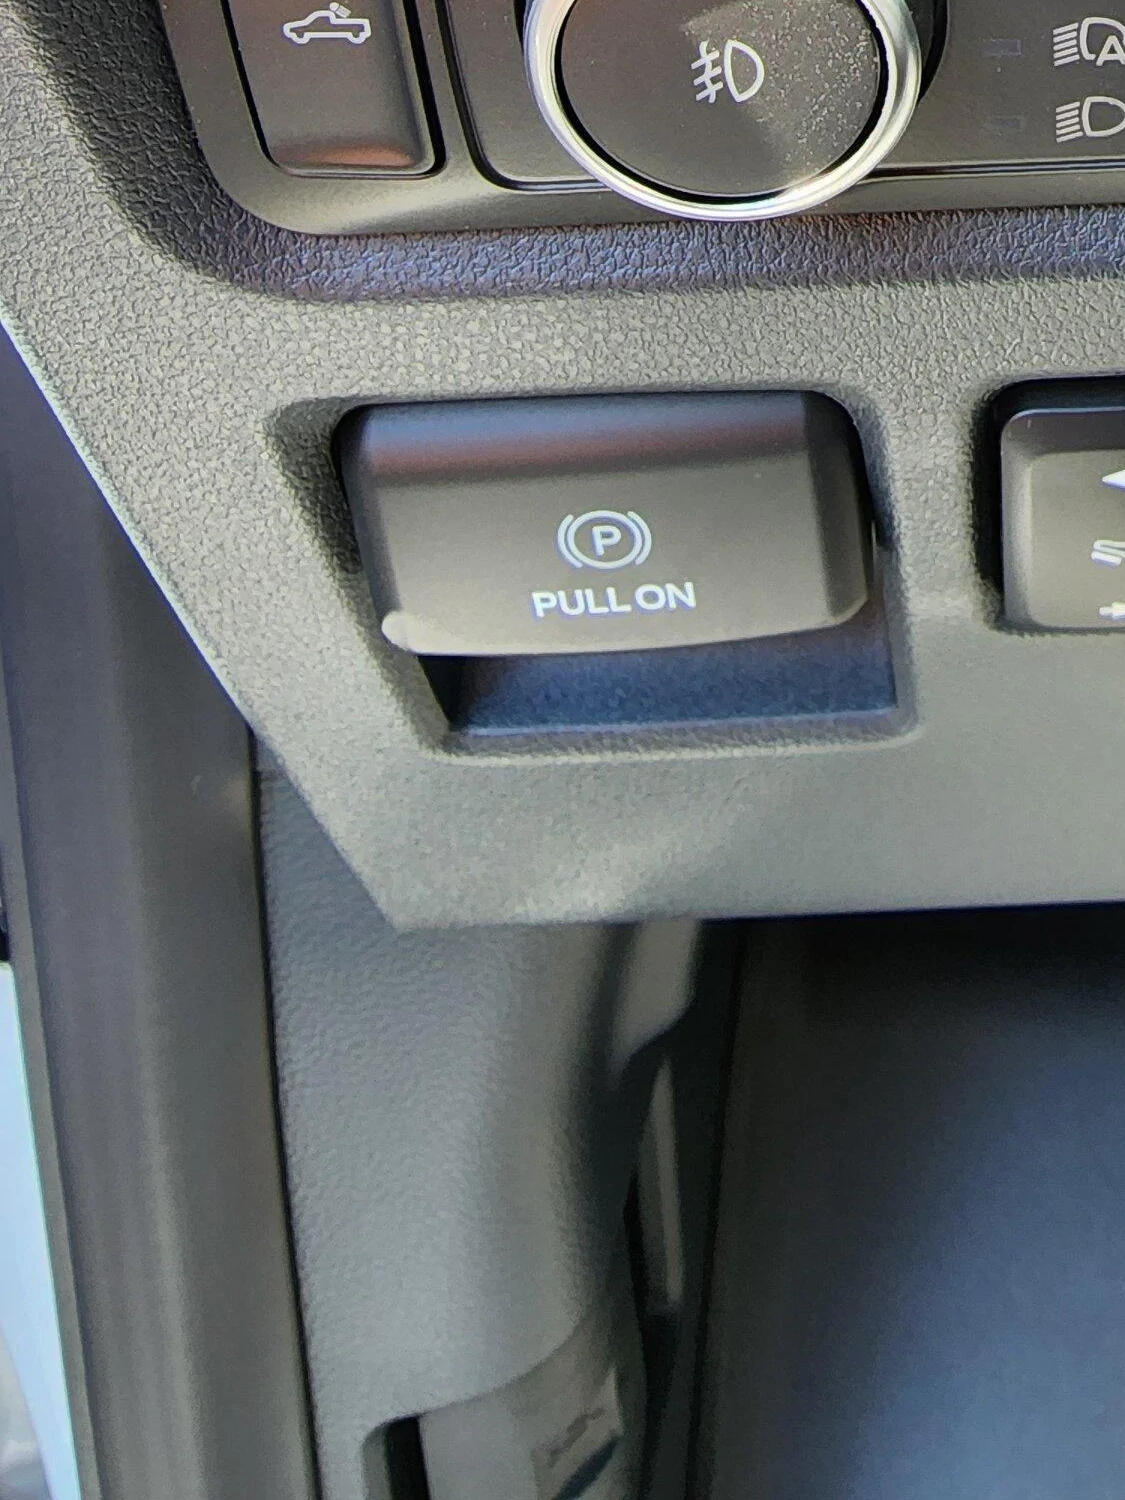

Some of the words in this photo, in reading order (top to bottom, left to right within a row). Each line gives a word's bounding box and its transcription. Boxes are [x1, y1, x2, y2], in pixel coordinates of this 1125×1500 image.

[591, 525, 622, 555] P
[531, 585, 631, 618] PULL
[634, 581, 698, 612] ON
